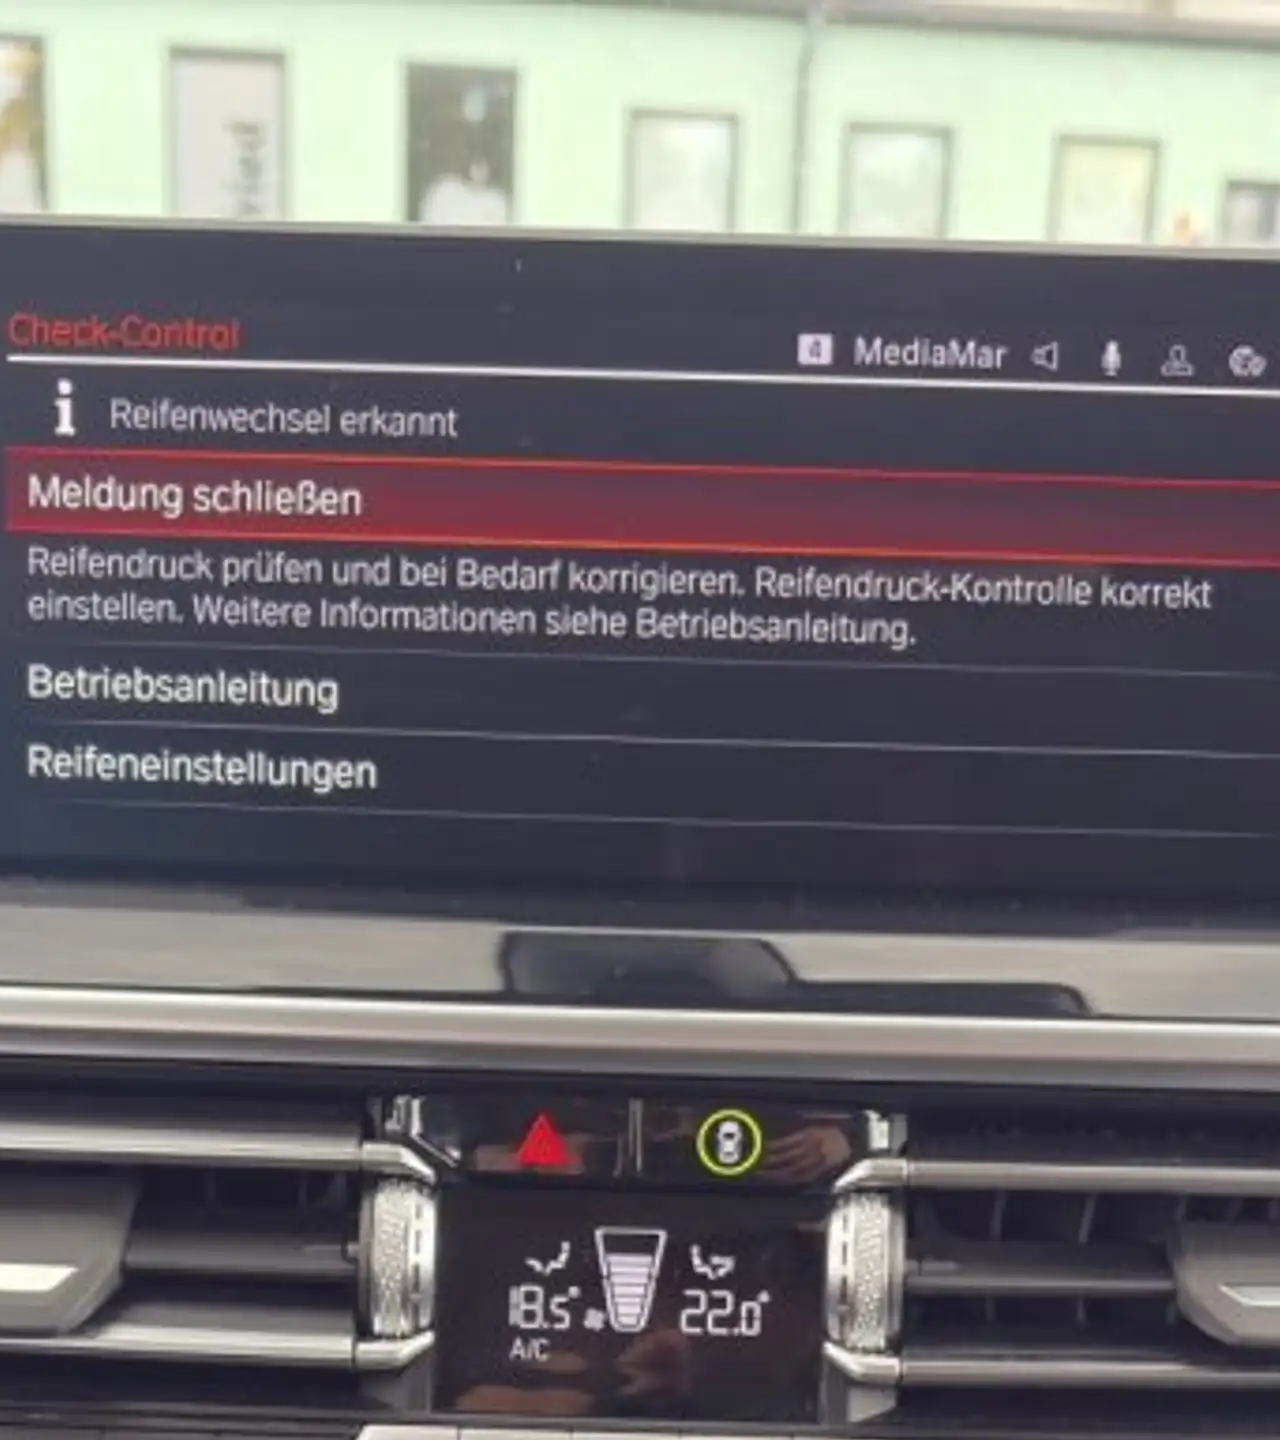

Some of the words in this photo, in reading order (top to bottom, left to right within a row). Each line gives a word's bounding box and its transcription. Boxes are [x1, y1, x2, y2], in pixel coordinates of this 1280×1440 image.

[6, 312, 242, 351] Check-Control
[853, 335, 1009, 371] MediaMar
[109, 398, 332, 436] Reifenwechsel
[339, 404, 459, 438] erkannt
[27, 472, 183, 519] Meldung
[192, 479, 364, 517] schließen
[27, 545, 215, 581] Reifendruck
[222, 548, 323, 586] prüfen
[331, 556, 391, 587] und
[399, 556, 448, 588] bei
[456, 557, 560, 592] Bedarf
[568, 563, 747, 601] korrigieren.
[754, 564, 1094, 607] Reifendruck-Kontrolle
[1100, 576, 1214, 609] korrekt
[27, 589, 184, 623] einstellen.
[192, 593, 313, 629] Weitere
[320, 599, 538, 635] Informationen
[544, 605, 627, 638] siehe
[634, 607, 918, 652] Betriebsanleitung.
[27, 661, 340, 715] Betriebsanleitung
[27, 743, 379, 794] Reifeneinstellungen
[508, 1338, 551, 1361] A/C
